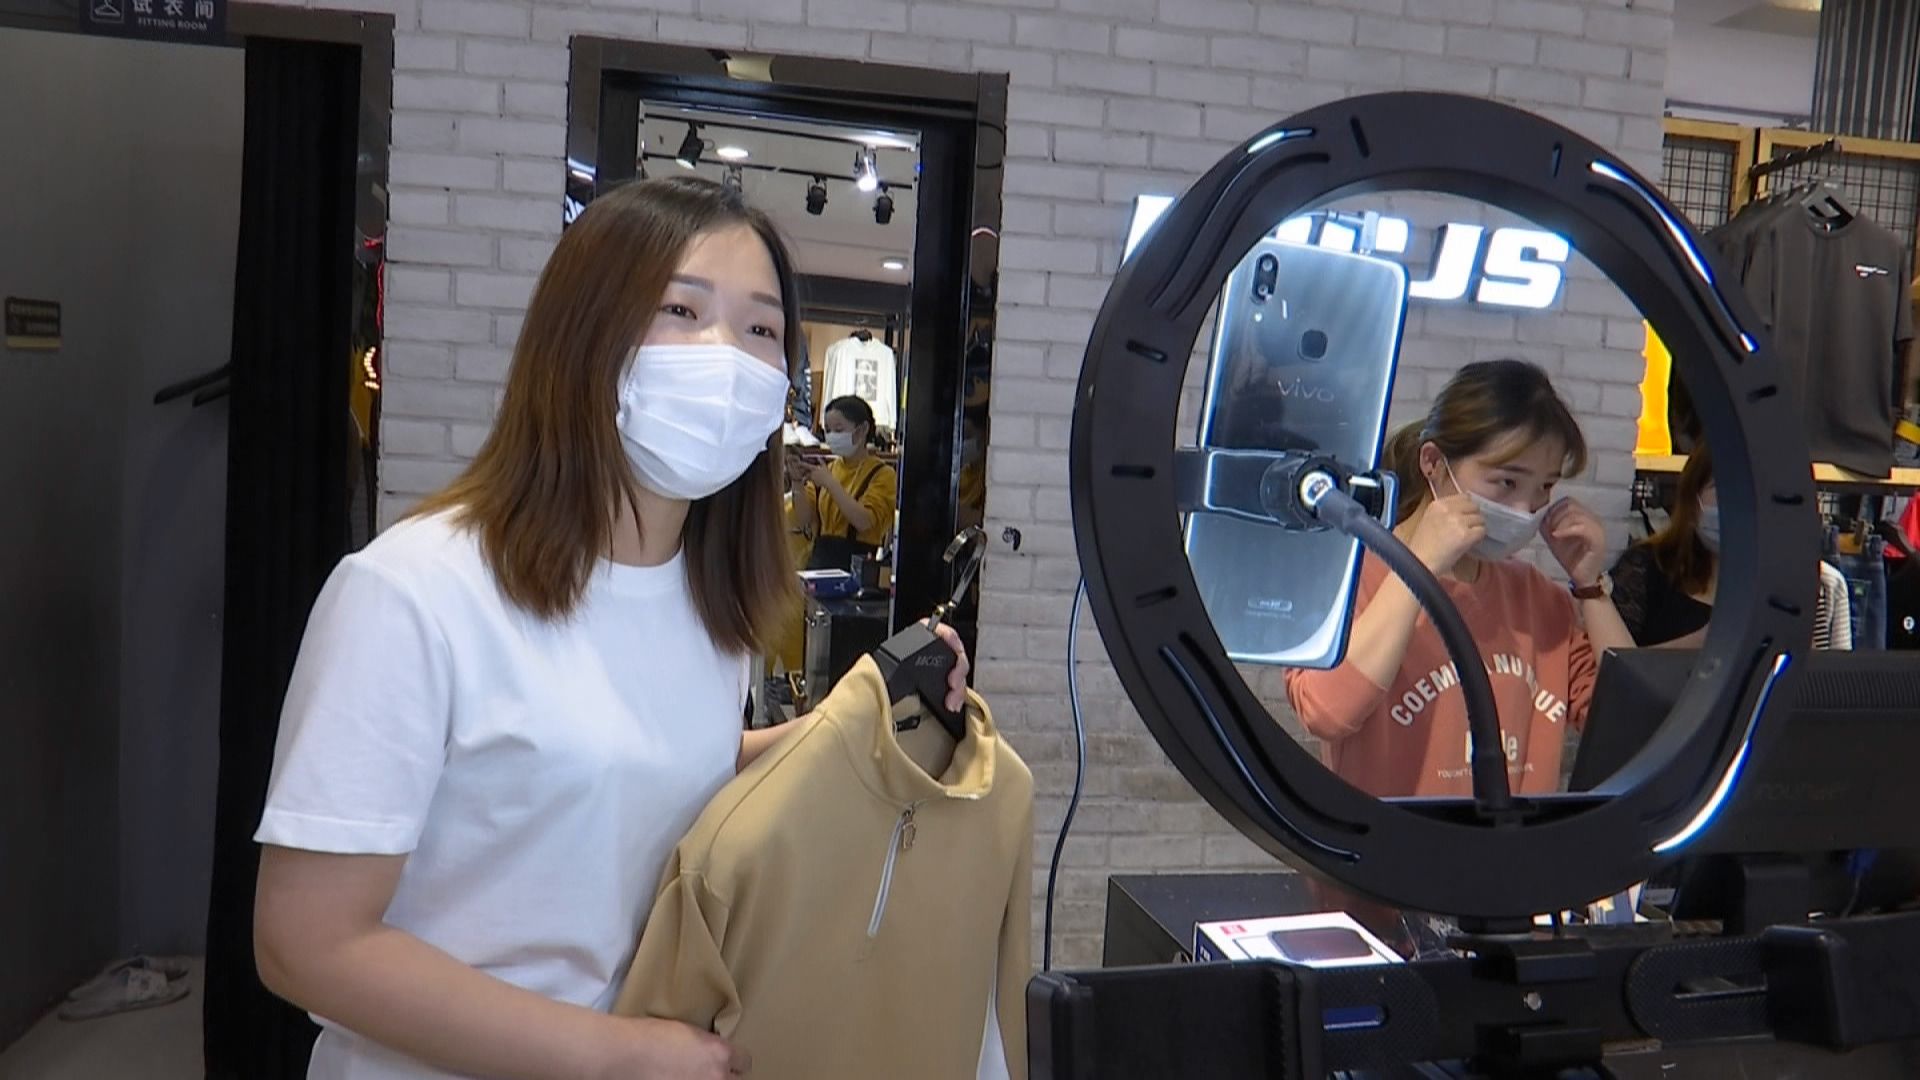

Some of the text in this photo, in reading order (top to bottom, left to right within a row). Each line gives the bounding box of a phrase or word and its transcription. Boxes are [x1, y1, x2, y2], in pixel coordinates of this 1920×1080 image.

[138, 17, 208, 31] FITTING ROOM
[1277, 376, 1336, 402] vivo
